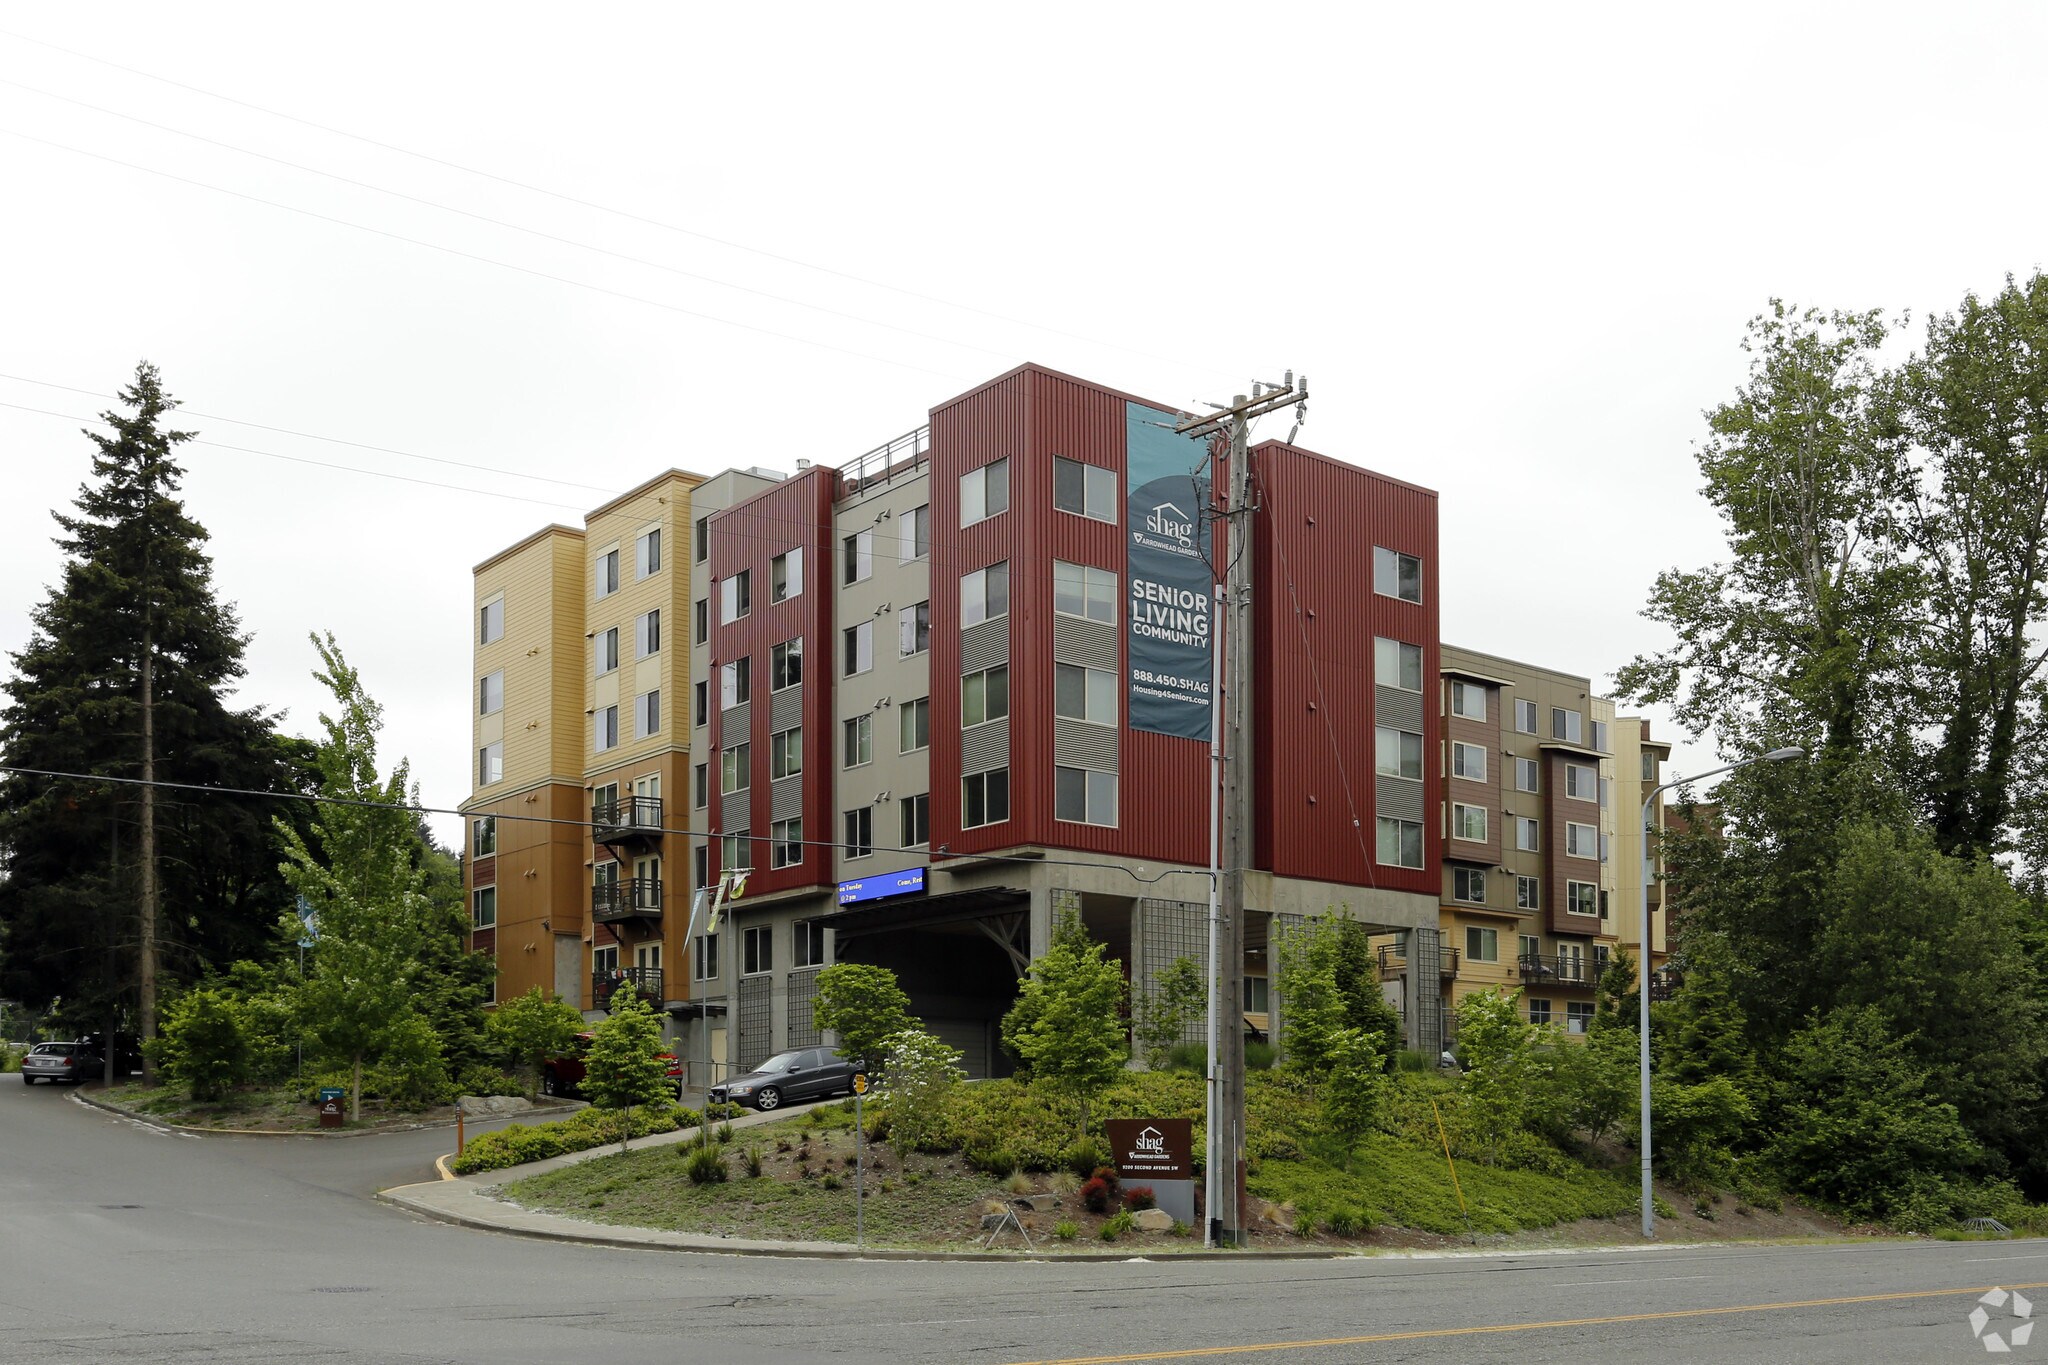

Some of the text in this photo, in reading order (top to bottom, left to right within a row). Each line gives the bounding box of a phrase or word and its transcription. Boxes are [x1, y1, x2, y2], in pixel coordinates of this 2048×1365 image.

[1146, 507, 1193, 548] shag
[1141, 538, 1177, 552] ARROWHEAD
[1132, 579, 1208, 614] SENIOR
[1133, 600, 1208, 635] LIVING
[1133, 622, 1208, 648] COMMUNITY
[1133, 669, 1209, 693] 888.450.SHAG
[1133, 684, 1209, 705] Housing4Seniors.com
[1136, 1131, 1164, 1155] shag
